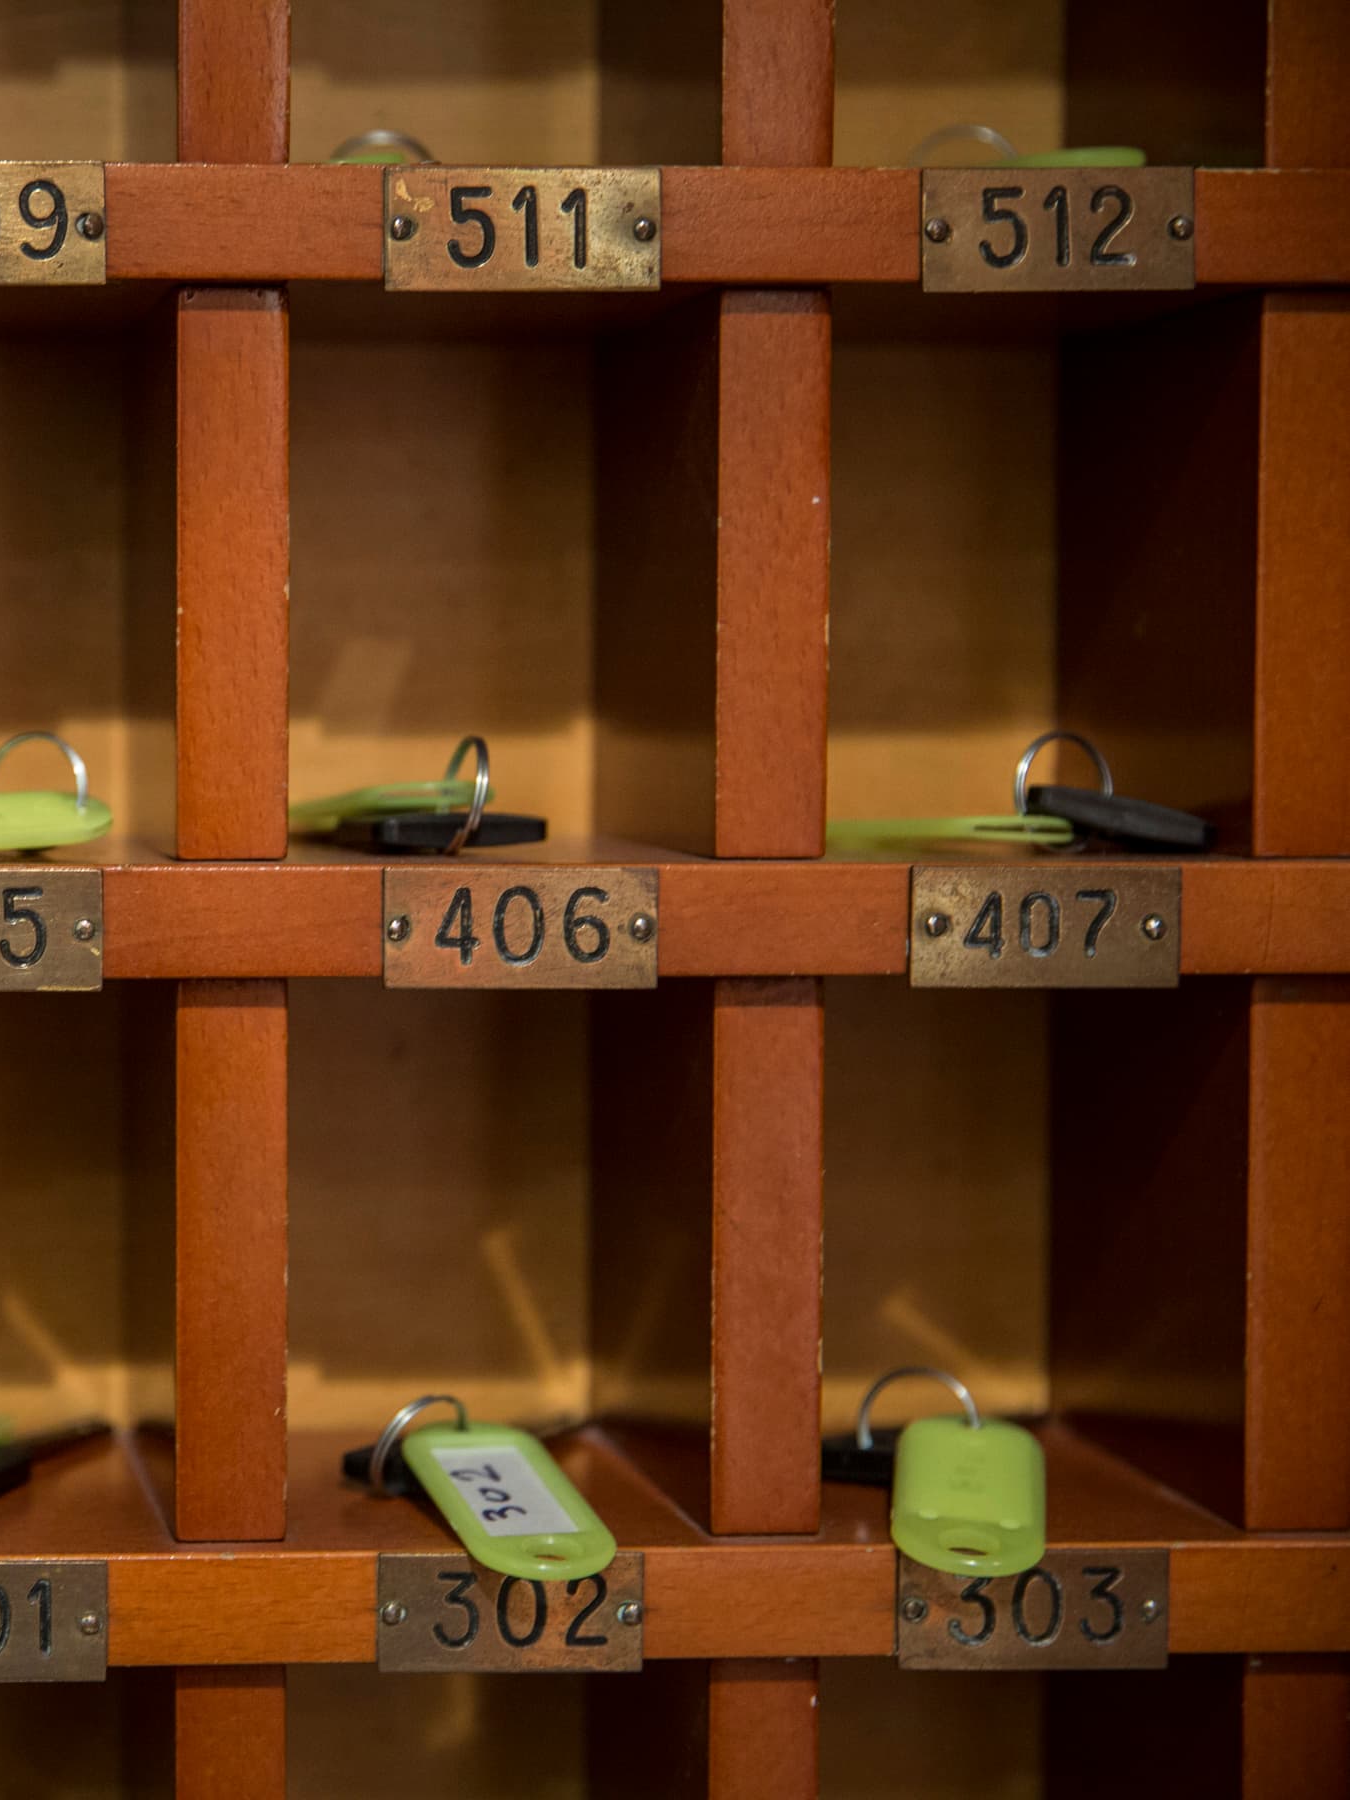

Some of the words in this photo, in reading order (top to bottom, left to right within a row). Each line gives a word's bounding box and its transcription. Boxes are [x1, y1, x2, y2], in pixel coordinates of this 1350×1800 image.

[446, 186, 586, 268] 511
[979, 185, 1136, 268] 512
[435, 885, 610, 966] 406
[963, 889, 1117, 959] 407
[450, 1464, 527, 1522] 302
[433, 1572, 608, 1648] 302
[950, 1566, 1124, 1647] 303
